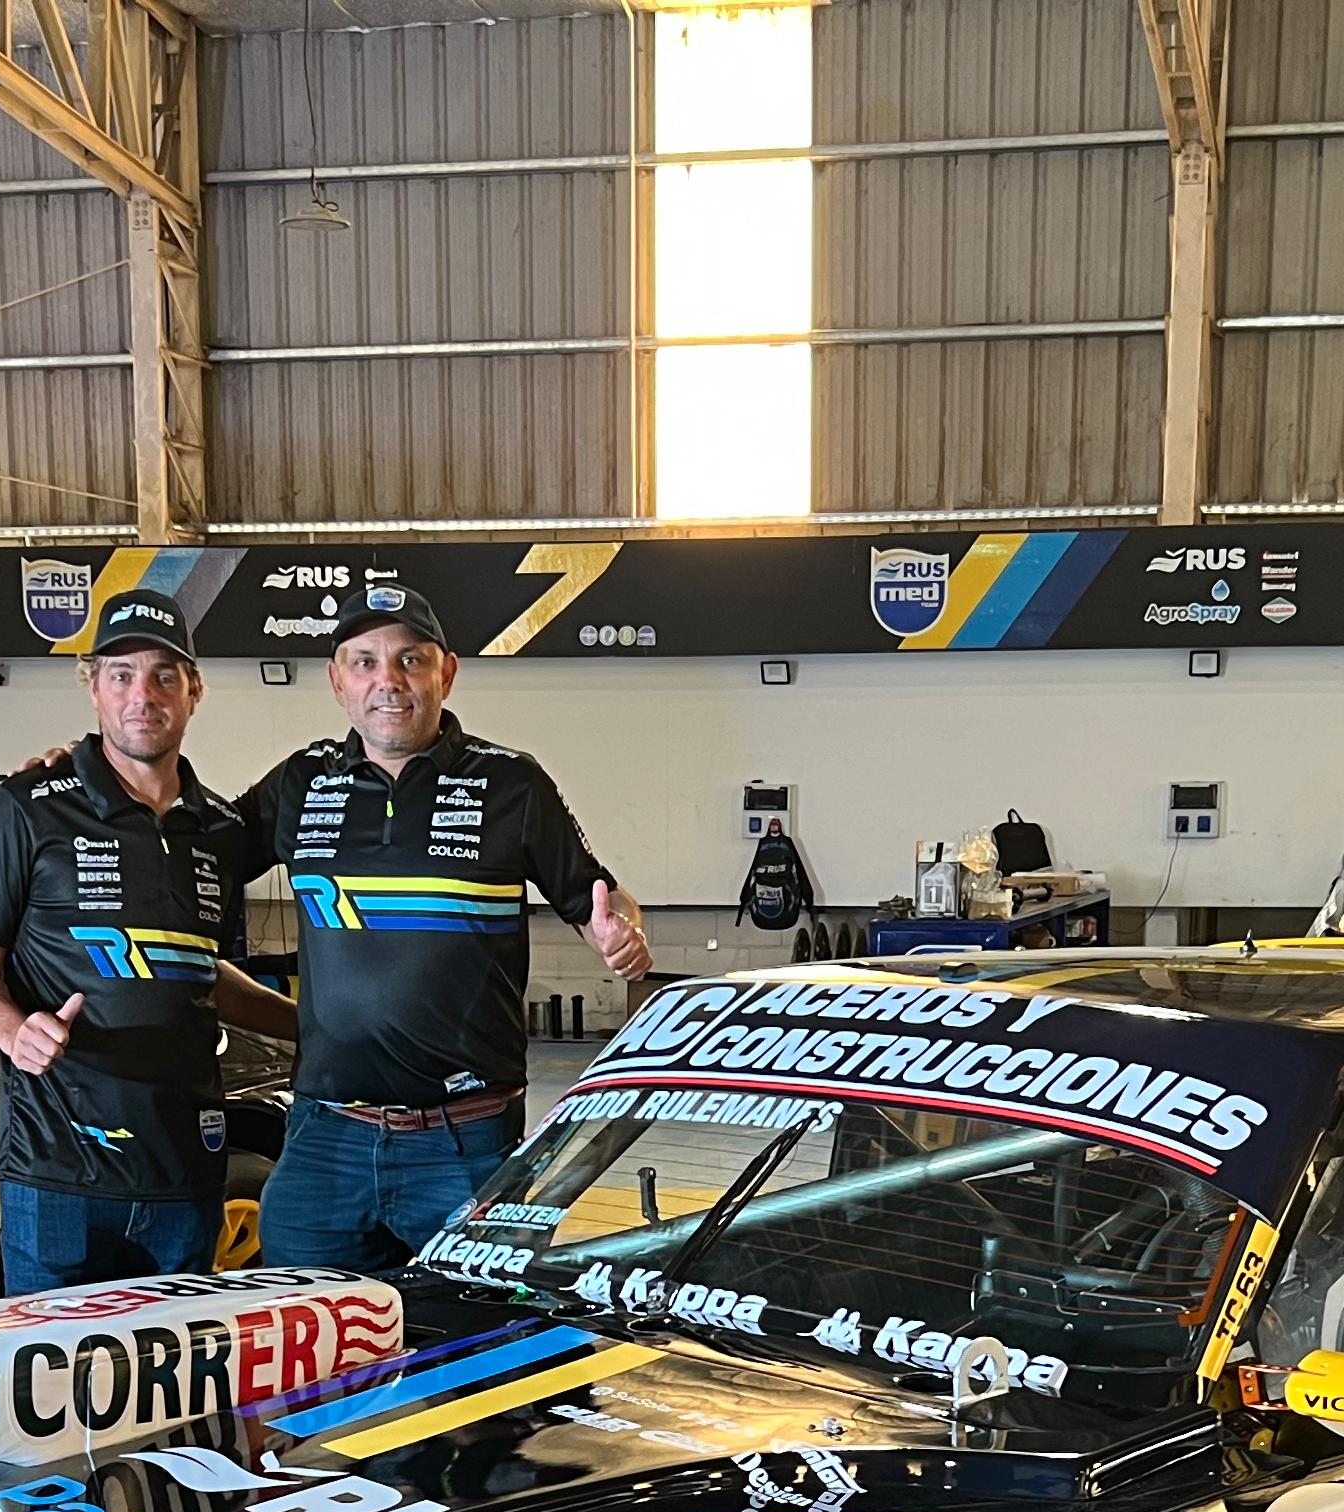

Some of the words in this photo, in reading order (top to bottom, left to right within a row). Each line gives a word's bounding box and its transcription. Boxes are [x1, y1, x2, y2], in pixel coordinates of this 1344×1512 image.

[903, 562, 945, 578] RUS
[1186, 548, 1246, 570] RUS
[51, 573, 88, 587] RUS
[297, 566, 350, 587] RUS
[31, 592, 84, 610] med
[479, 542, 623, 655] 7
[879, 583, 939, 601] med
[135, 605, 175, 627] RUS
[1144, 603, 1241, 625] AgroSpray
[428, 845, 479, 860] COLCAR
[746, 984, 1000, 1028] ACEROS
[1006, 995, 1072, 1033] Y
[689, 1025, 1268, 1151] CONSTRUCCIONES
[634, 1091, 845, 1133] RULEMANES
[435, 1231, 536, 1276] Kappa
[13, 1294, 321, 1437] CORRER
